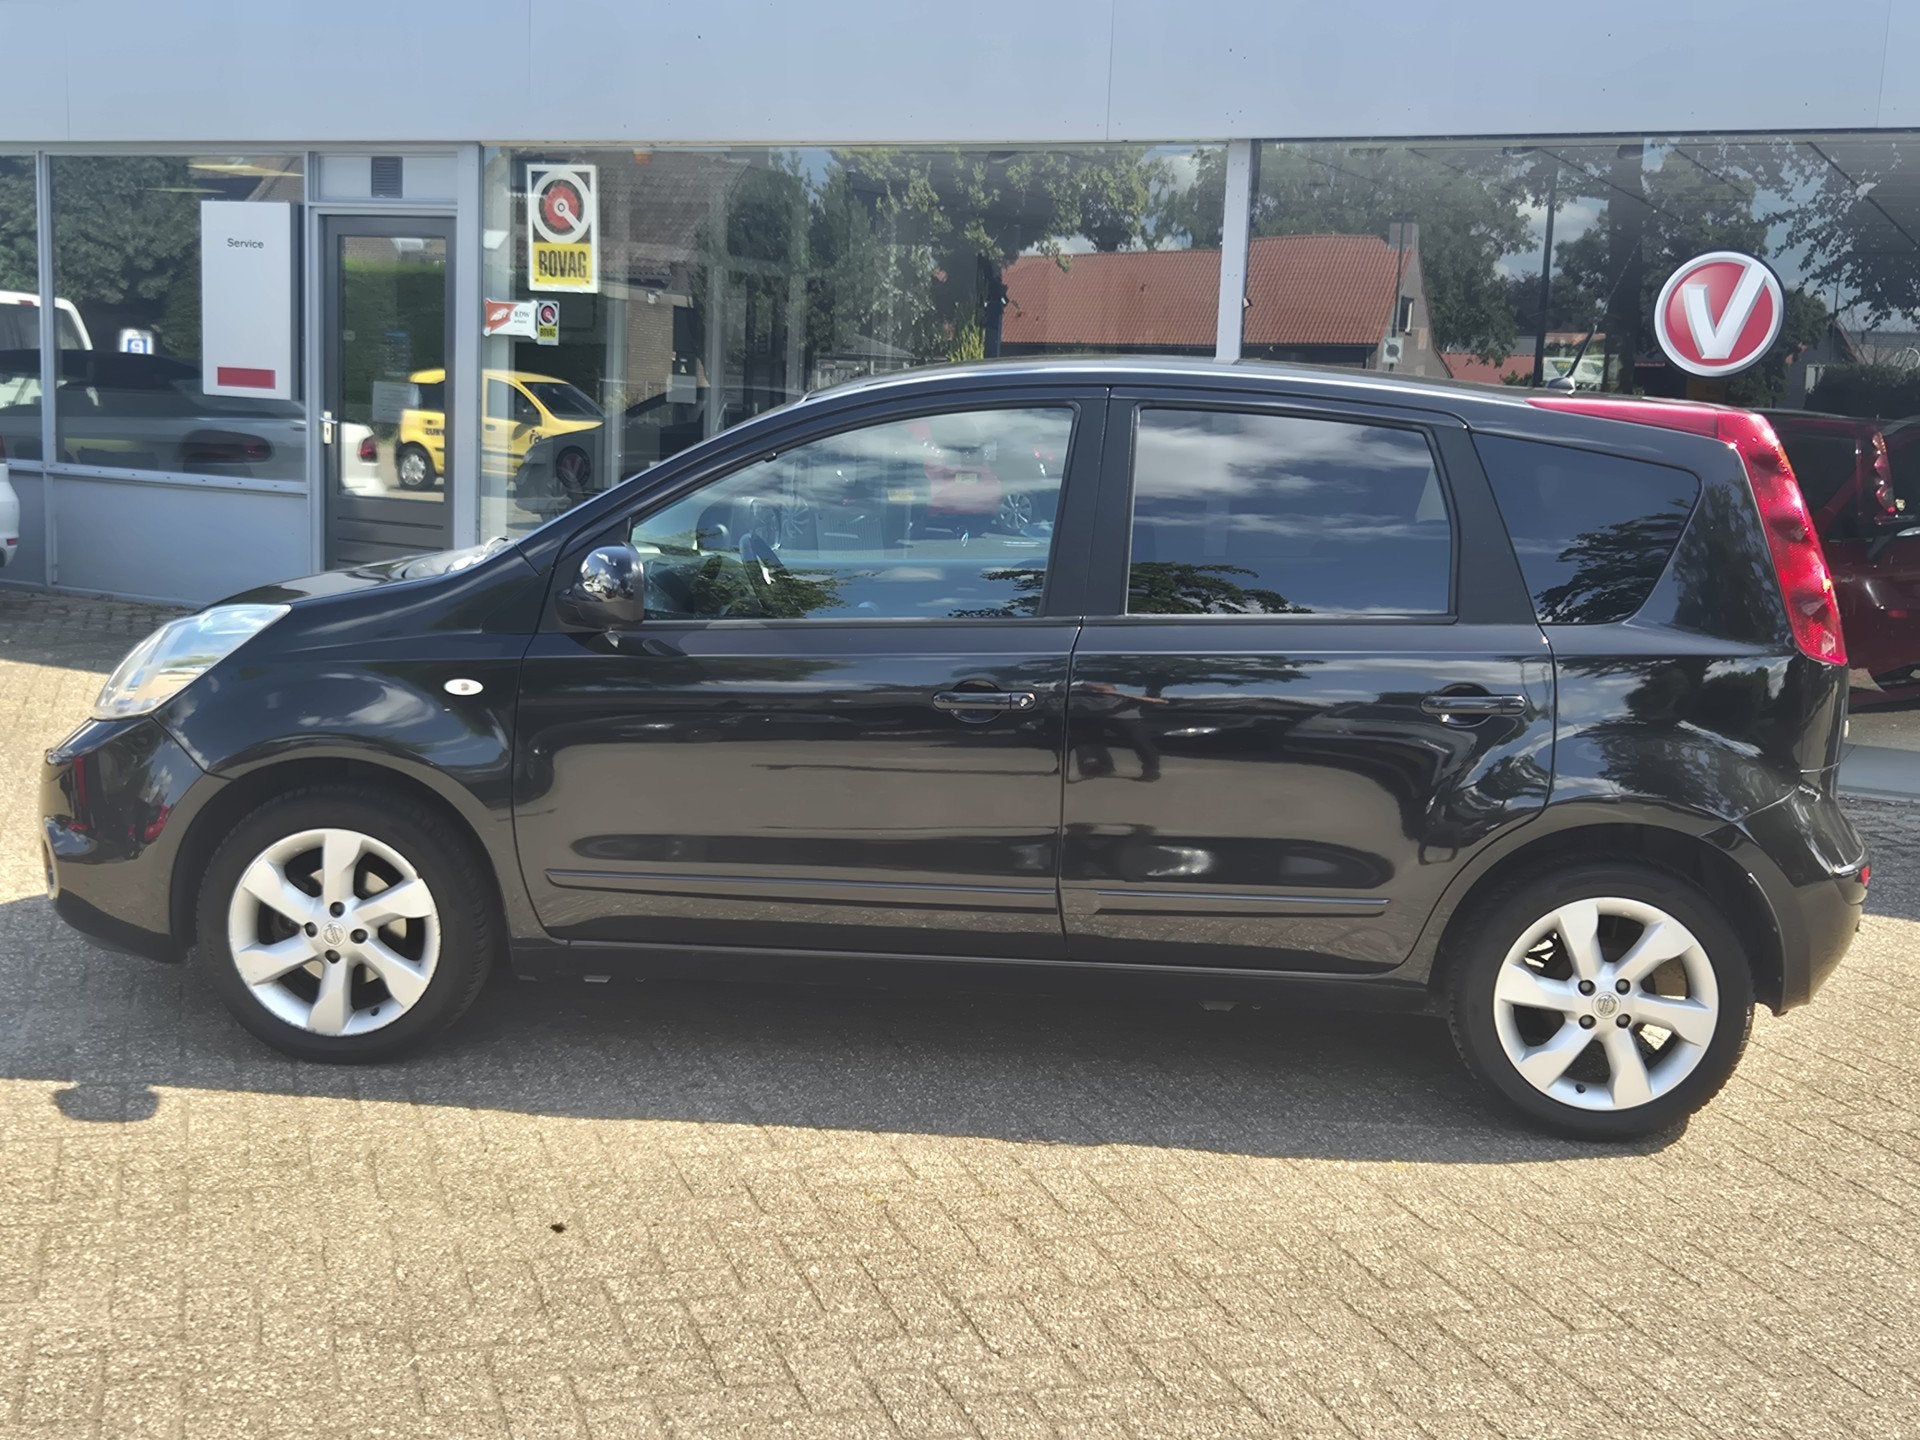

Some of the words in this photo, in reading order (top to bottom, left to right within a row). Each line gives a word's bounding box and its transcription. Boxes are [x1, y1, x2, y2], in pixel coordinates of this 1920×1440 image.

[226, 238, 265, 249] Service
[538, 250, 587, 278] BOVAG
[1682, 262, 1766, 360] V
[539, 327, 557, 338] BOVAG
